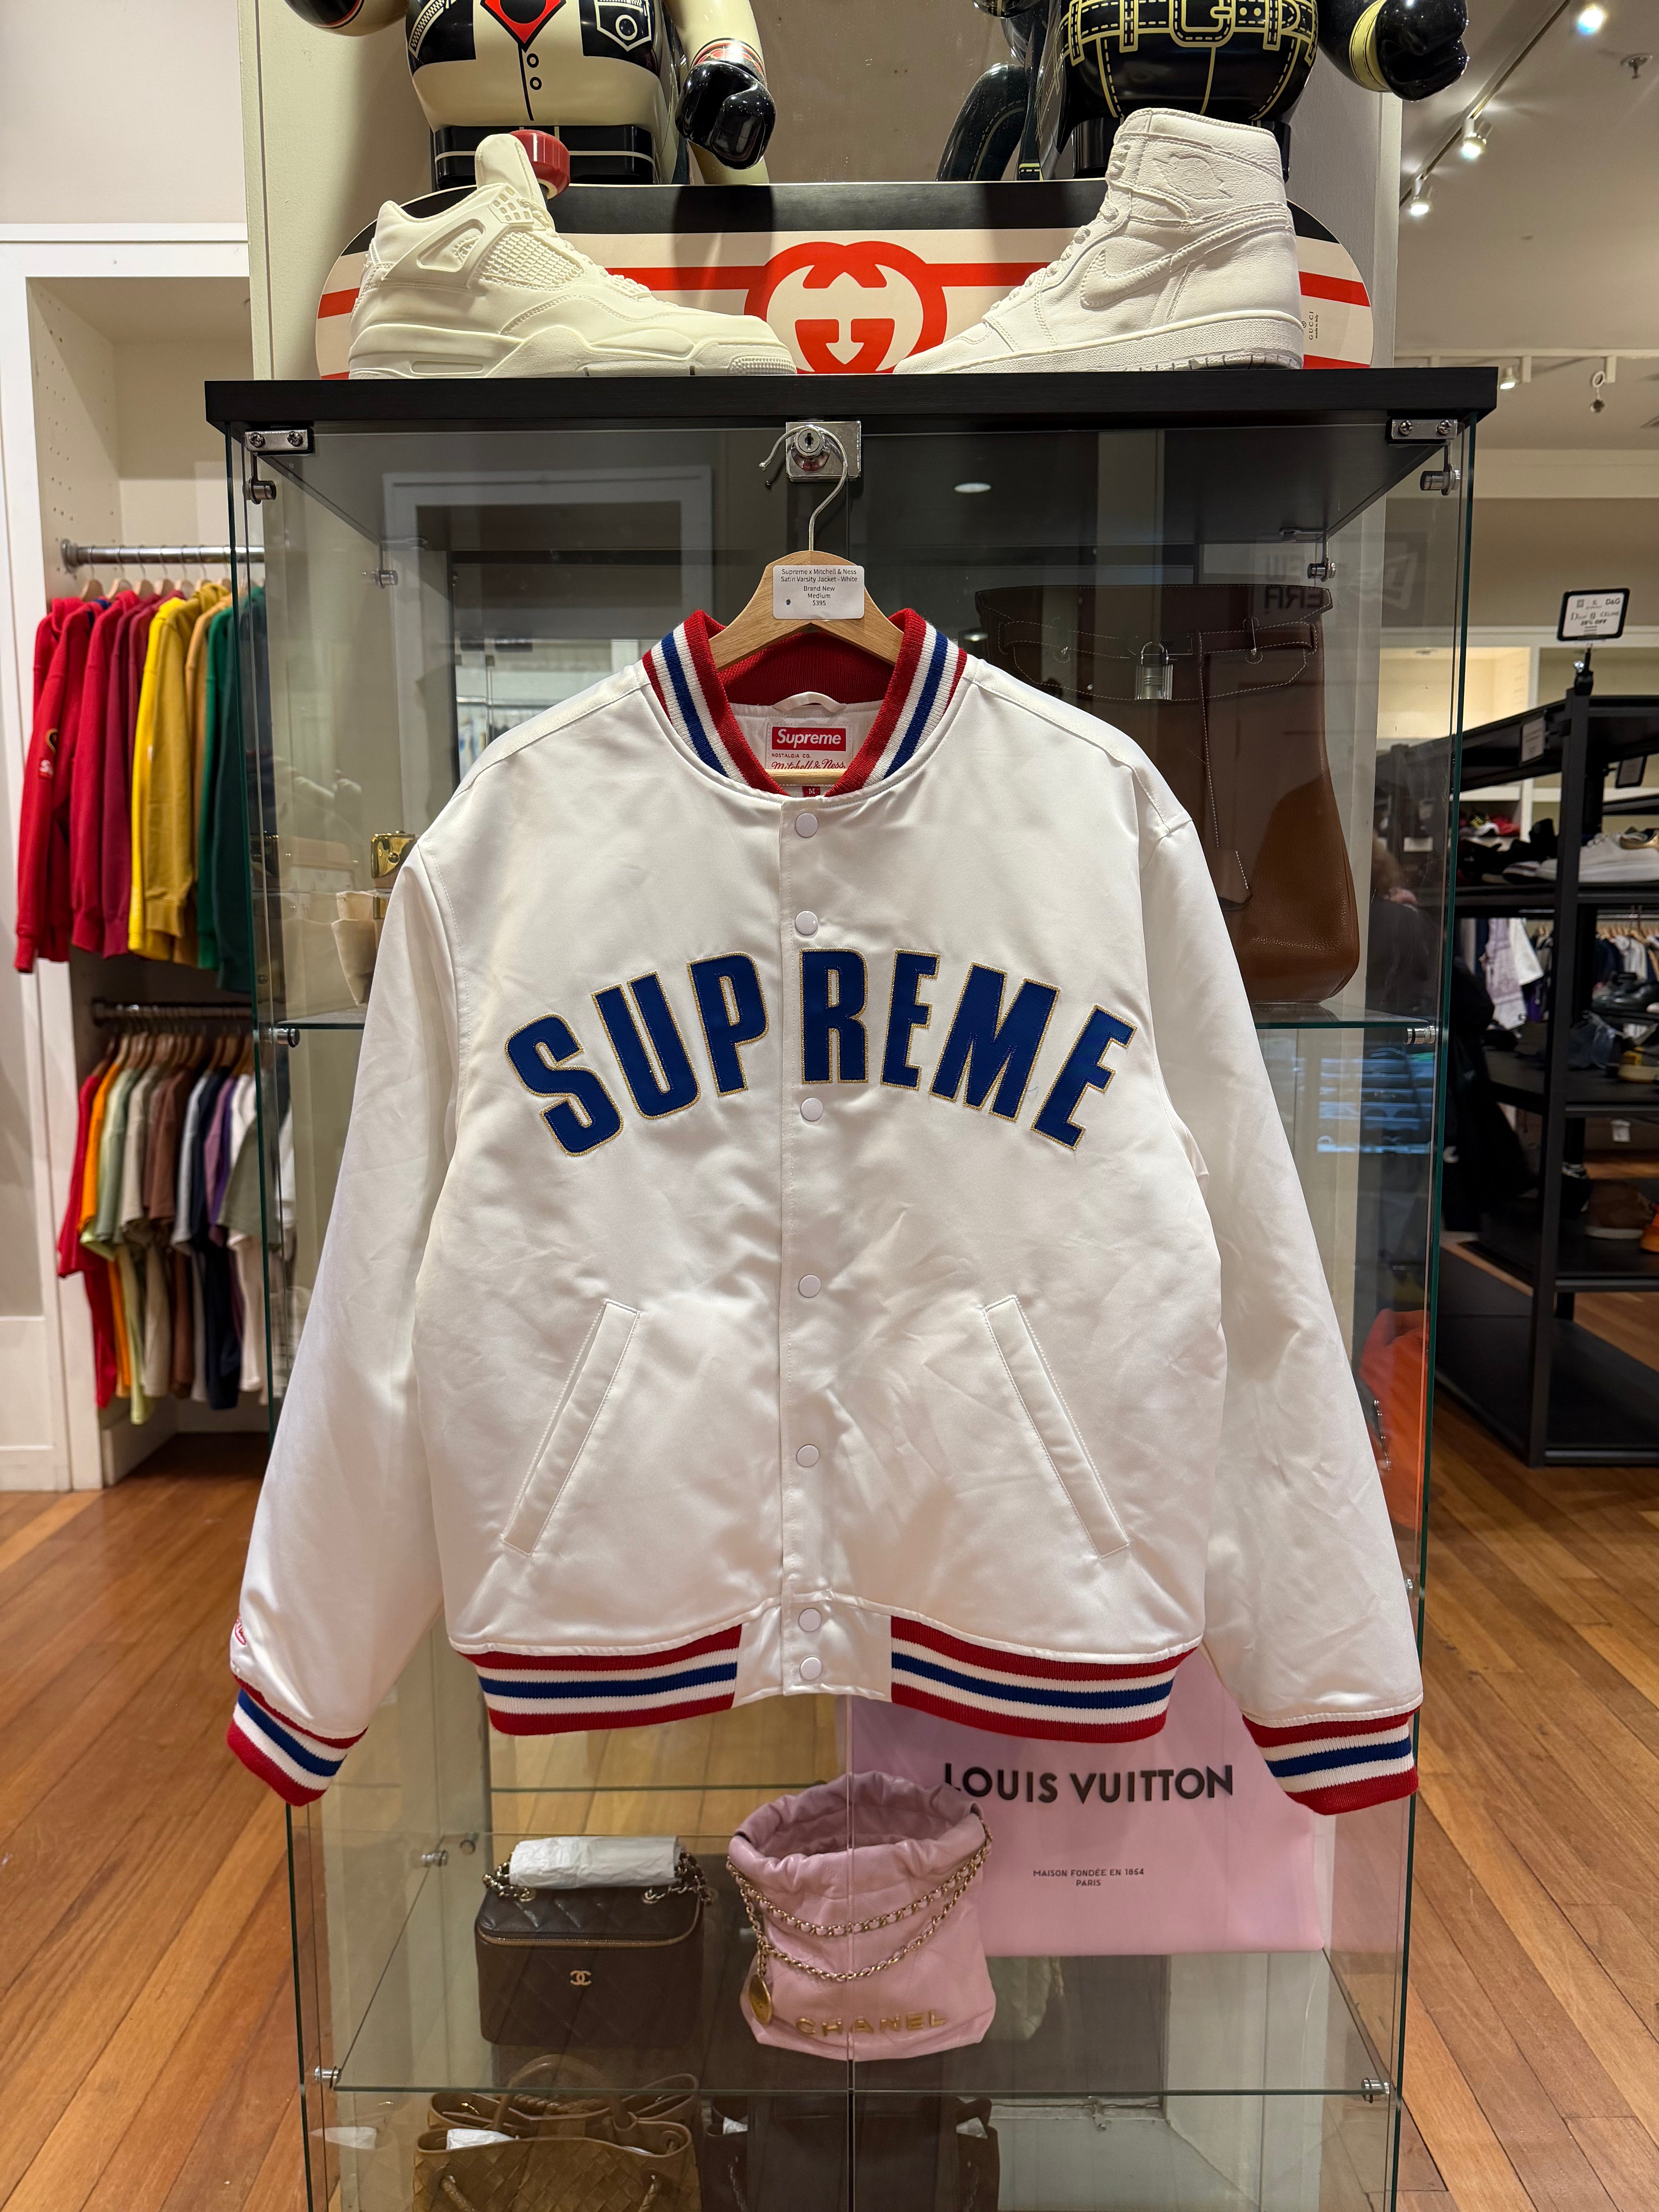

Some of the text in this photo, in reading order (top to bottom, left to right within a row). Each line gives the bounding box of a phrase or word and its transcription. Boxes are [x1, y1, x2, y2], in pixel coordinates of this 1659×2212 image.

[776, 728, 842, 749] Supreme
[505, 947, 1137, 1157] SUPREME
[945, 1762, 1233, 1804] LOUIS VUITTON
[1071, 1868, 1106, 1877] FONDÉE
[796, 2010, 947, 2037] CHANEL
